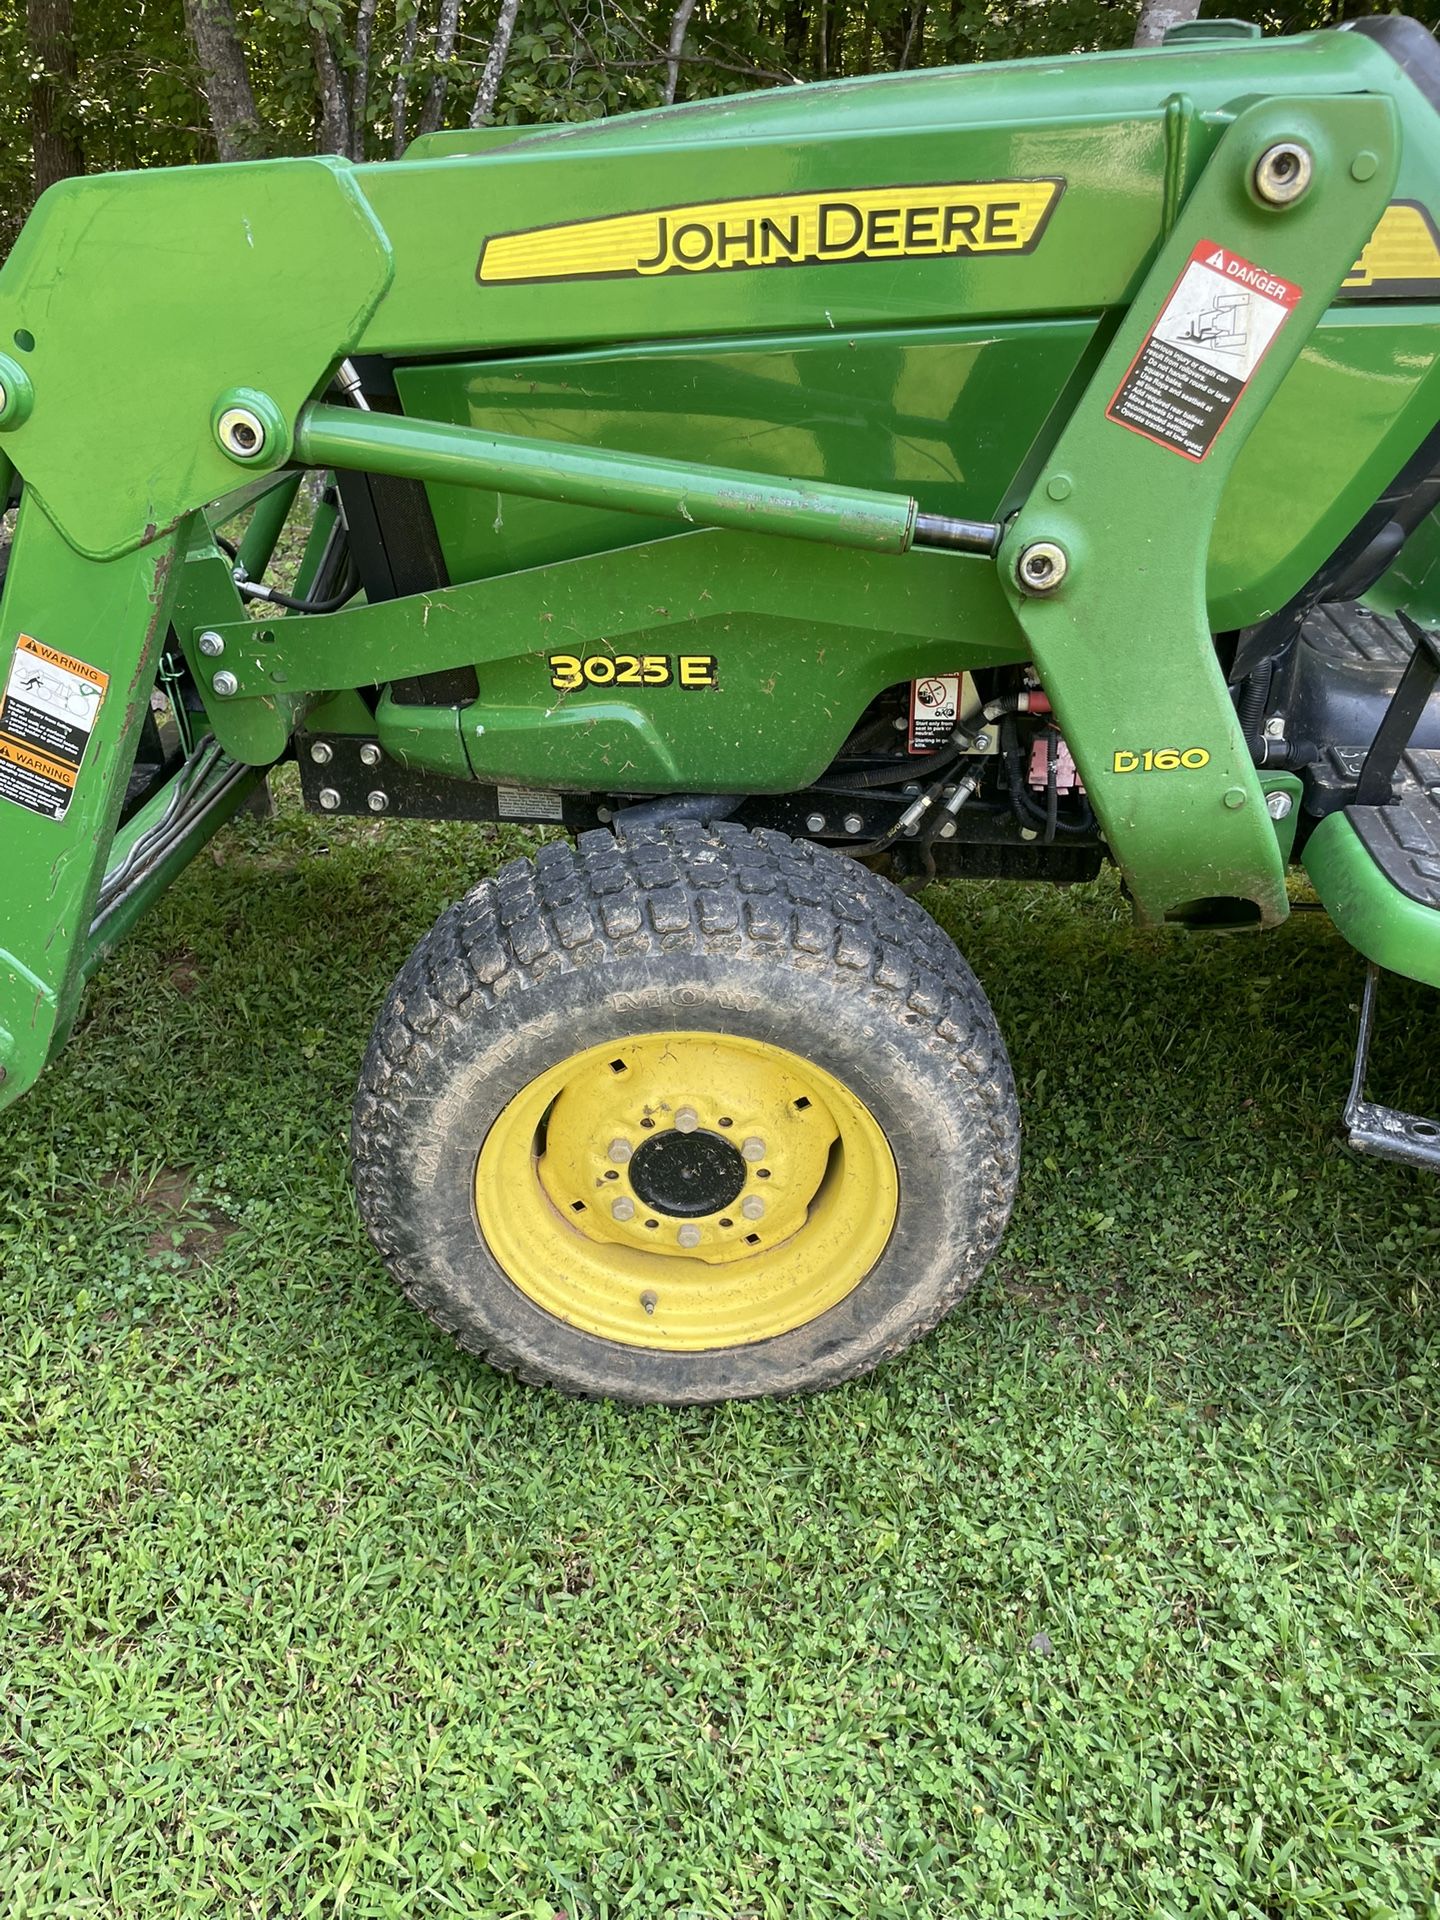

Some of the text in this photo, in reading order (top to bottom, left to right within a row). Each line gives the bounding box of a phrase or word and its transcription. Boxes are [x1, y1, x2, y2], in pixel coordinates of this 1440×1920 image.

[637, 201, 1021, 269] JOHN DEERE
[1226, 260, 1287, 300] DANGER
[1144, 366, 1183, 387] square bales.
[1146, 348, 1207, 381] result from rollovers.
[1150, 340, 1174, 355] Serious
[1173, 352, 1191, 364] injury
[1198, 365, 1216, 376] death
[1216, 373, 1228, 383] can
[1136, 379, 1163, 395] all times.
[1140, 372, 1153, 382] Use
[1169, 386, 1181, 396] and
[1181, 393, 1205, 407] seatbelt
[1205, 404, 1212, 412] at
[1148, 357, 1158, 366] Do
[1158, 362, 1168, 372] not
[1169, 369, 1189, 381] handle
[1189, 379, 1207, 390] round
[1214, 392, 1231, 403] large
[1124, 401, 1189, 436] recommended setting.
[1128, 394, 1145, 404] Move
[1145, 402, 1167, 415] wheels
[1174, 417, 1194, 428] widest
[1132, 386, 1205, 425] Add required rear ballast.
[1120, 408, 1145, 422] Operate
[1145, 420, 1166, 432] tractor
[1172, 432, 1184, 442] low
[1183, 439, 1204, 452] speed.
[41, 647, 98, 680] WARNING
[550, 655, 671, 689] 3025
[16, 752, 71, 783] WARNING
[1113, 746, 1211, 773] D160
[415, 1012, 554, 1188] MIGHTY
[612, 985, 762, 1012] MOW
